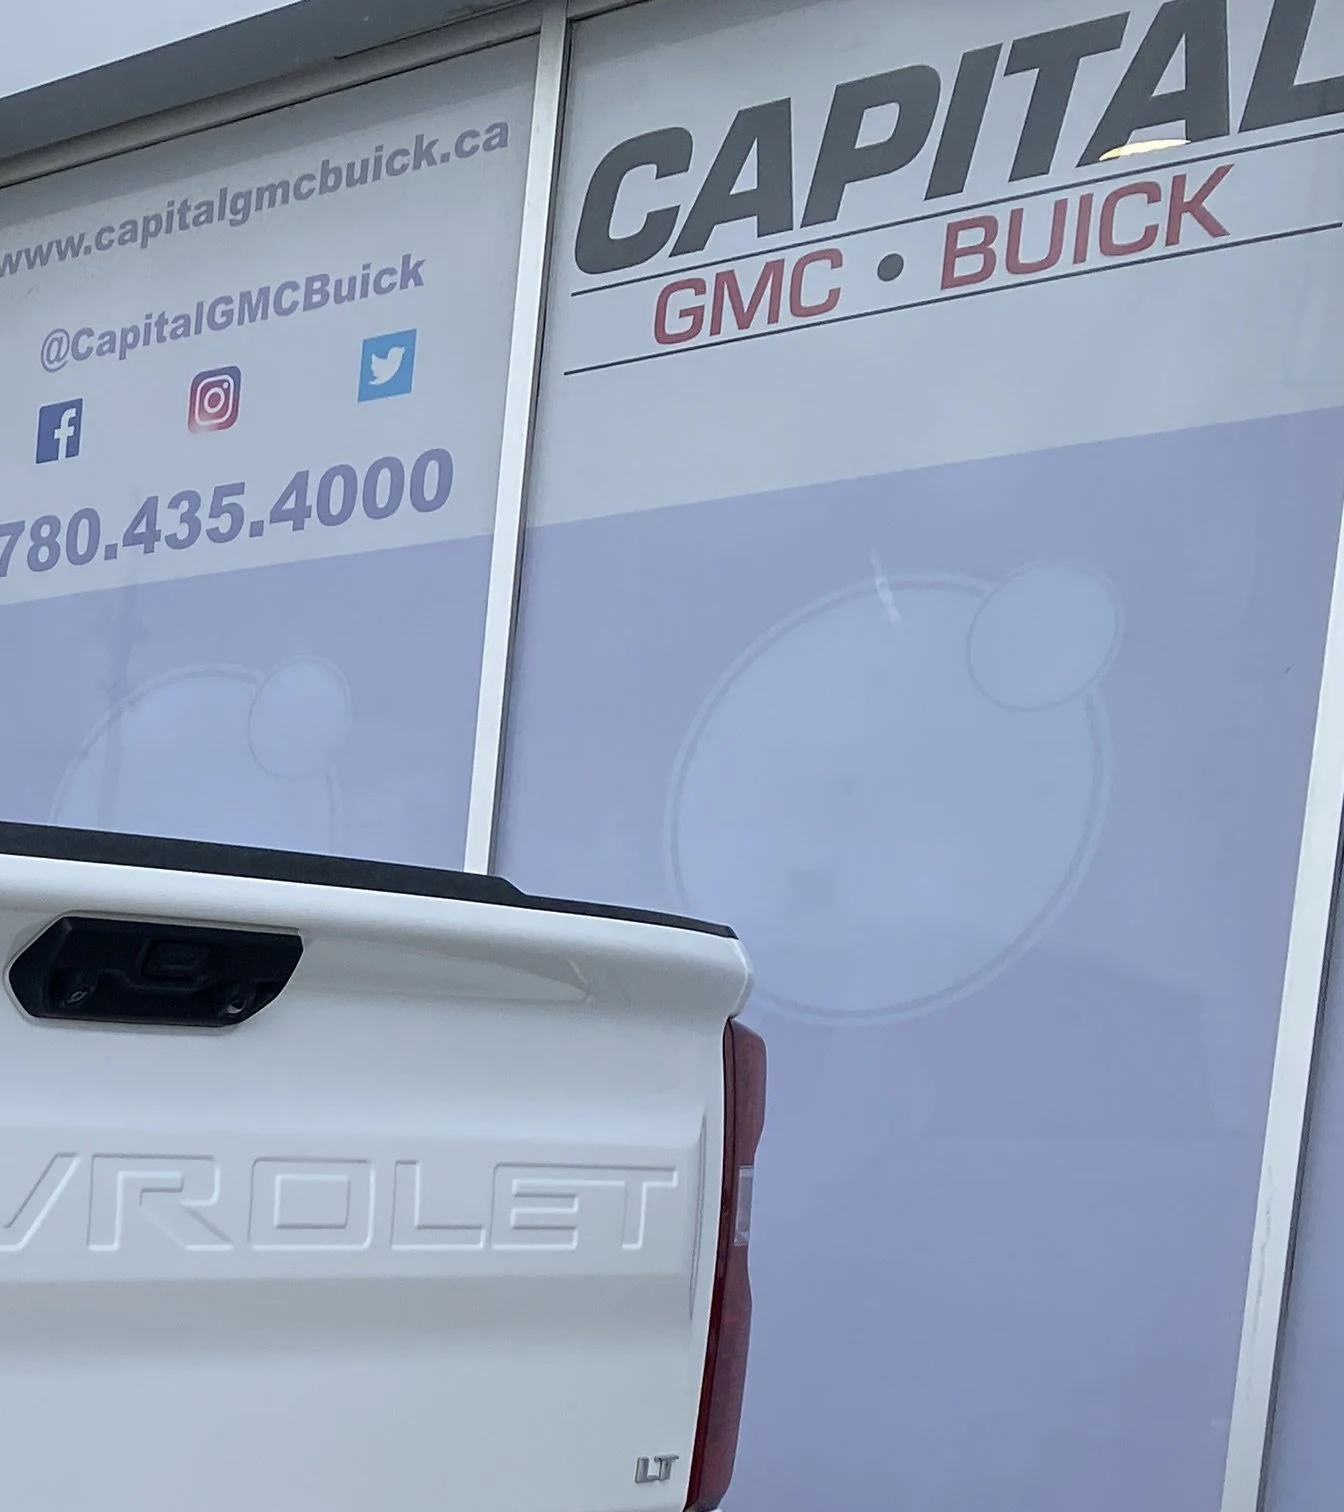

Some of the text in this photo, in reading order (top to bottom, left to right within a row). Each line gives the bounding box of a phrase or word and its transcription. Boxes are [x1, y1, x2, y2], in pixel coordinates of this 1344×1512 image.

[575, 0, 1344, 274] CAPITAL
[40, 253, 425, 372] @CapitalGMCBuick
[654, 164, 1234, 345] GMC BUICK
[635, 1454, 679, 1483] LT
